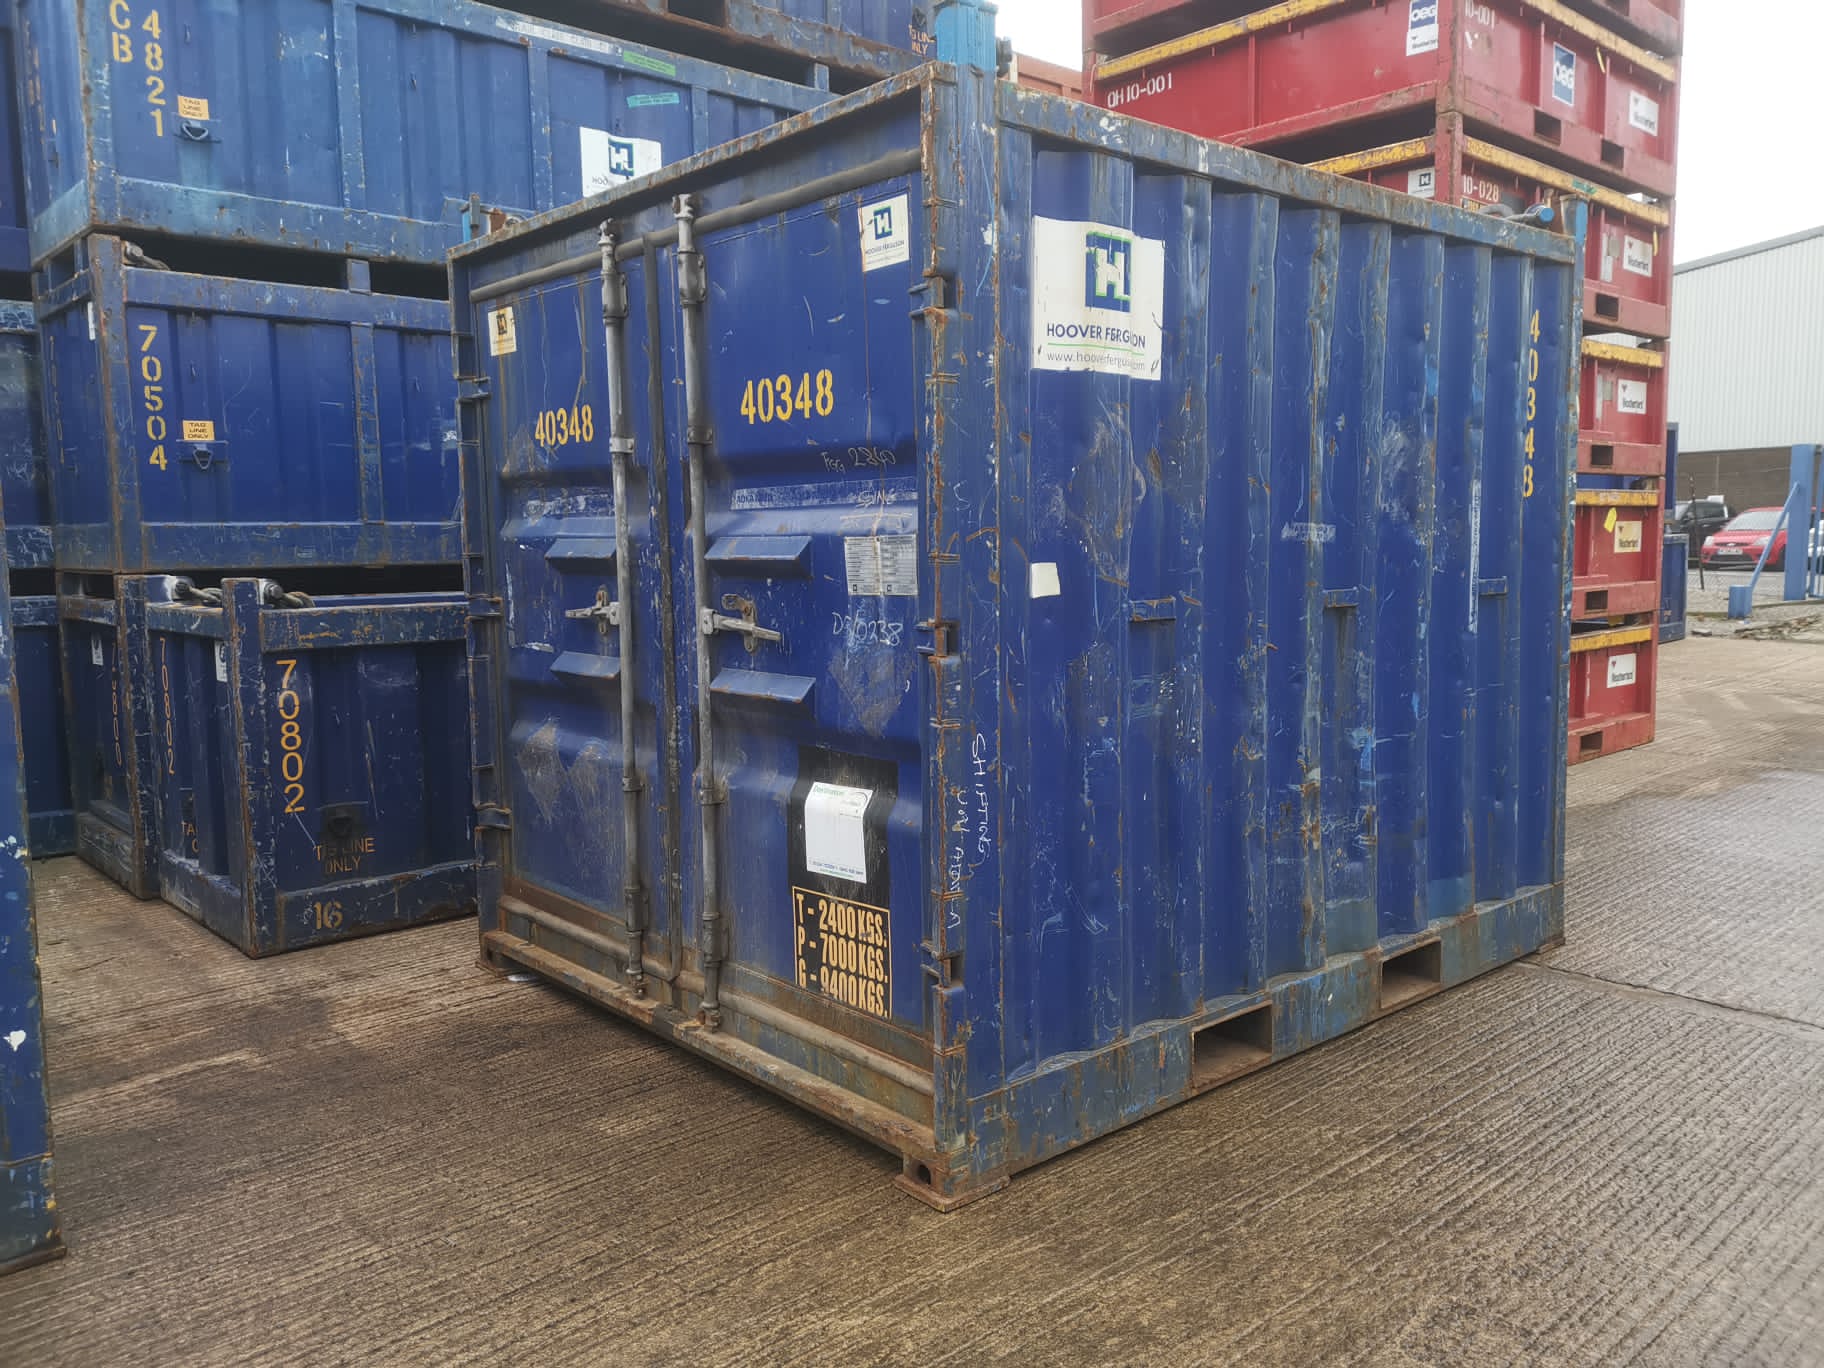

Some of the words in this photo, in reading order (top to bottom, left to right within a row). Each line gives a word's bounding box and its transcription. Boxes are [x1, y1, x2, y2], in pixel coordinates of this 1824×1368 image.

[142, 9, 166, 137] 4821
[1047, 322, 1102, 340] HOOVER
[138, 324, 168, 471] 70504
[740, 368, 834, 425] 40348
[1523, 309, 1540, 498] 40348
[534, 404, 594, 448] 40348
[276, 659, 305, 814] 70802
[796, 893, 804, 924] T
[819, 898, 857, 939] 2400
[797, 925, 806, 957] P
[820, 932, 857, 973] 7000
[799, 957, 807, 989] G
[820, 966, 857, 1007] 9400
